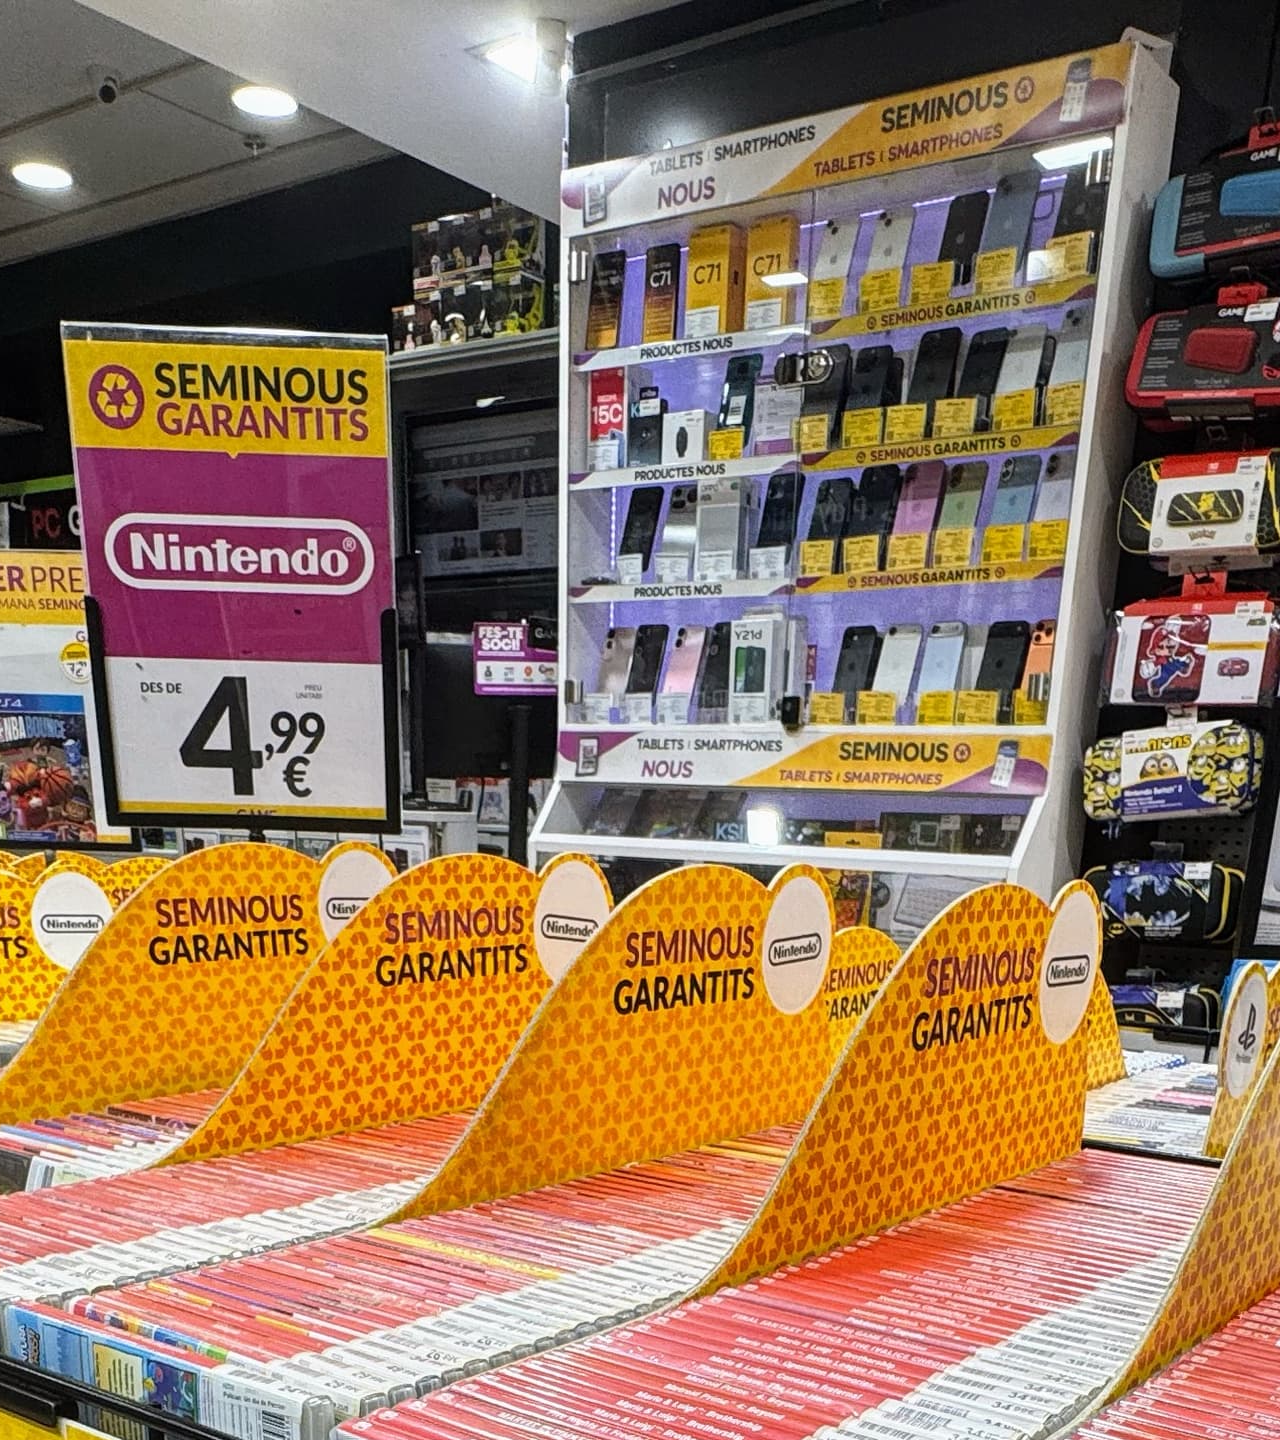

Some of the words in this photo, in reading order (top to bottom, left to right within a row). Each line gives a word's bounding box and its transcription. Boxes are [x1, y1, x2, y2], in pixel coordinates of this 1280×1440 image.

[880, 80, 1010, 134] SEMINOUS
[649, 149, 705, 177] TABLETS
[714, 125, 816, 162] SMARTPHONES
[814, 150, 876, 178] TABLETS
[887, 122, 1004, 163] SMARTPHONES
[656, 176, 716, 210] NOUS
[693, 262, 722, 286] C71
[752, 252, 782, 278] C71
[880, 306, 943, 329] SEMINOUS
[945, 294, 1021, 318] GARANTITS
[640, 340, 701, 361] PRODUCTES
[703, 336, 733, 352] NOUS
[154, 362, 369, 405] SEMINOUS
[157, 402, 369, 442] GARANTITS
[870, 443, 931, 463] SEMINOUS
[933, 436, 1006, 456] GARANTITS
[634, 465, 694, 482] PRODUCTES
[695, 462, 726, 477] NOUS
[32, 508, 62, 540] PC
[130, 532, 350, 577] Nintendo
[633, 584, 694, 599] PRODUCTES
[695, 583, 723, 597] NOUS
[860, 571, 919, 589] SEMINOUS
[920, 567, 991, 585] GARANTITS
[140, 681, 164, 694] DES
[166, 682, 183, 694] DE
[3, 715, 26, 741] NBA
[641, 758, 694, 779] NOUS
[838, 740, 949, 764] SEMINOUS
[778, 768, 833, 785] TABLETS
[842, 770, 943, 787] SMARTPHONES
[156, 894, 303, 930] SEMINOUS
[385, 904, 524, 946] SEMINOUS
[148, 928, 309, 966] GARANTITS
[624, 925, 754, 968] SEMINOUS
[375, 943, 528, 987] GARANTITS
[924, 946, 1036, 1000] SEMINOUS
[1045, 958, 1090, 986] Nintendo
[612, 967, 754, 1016] GARANTITS
[911, 992, 1034, 1053] GARANTITS
